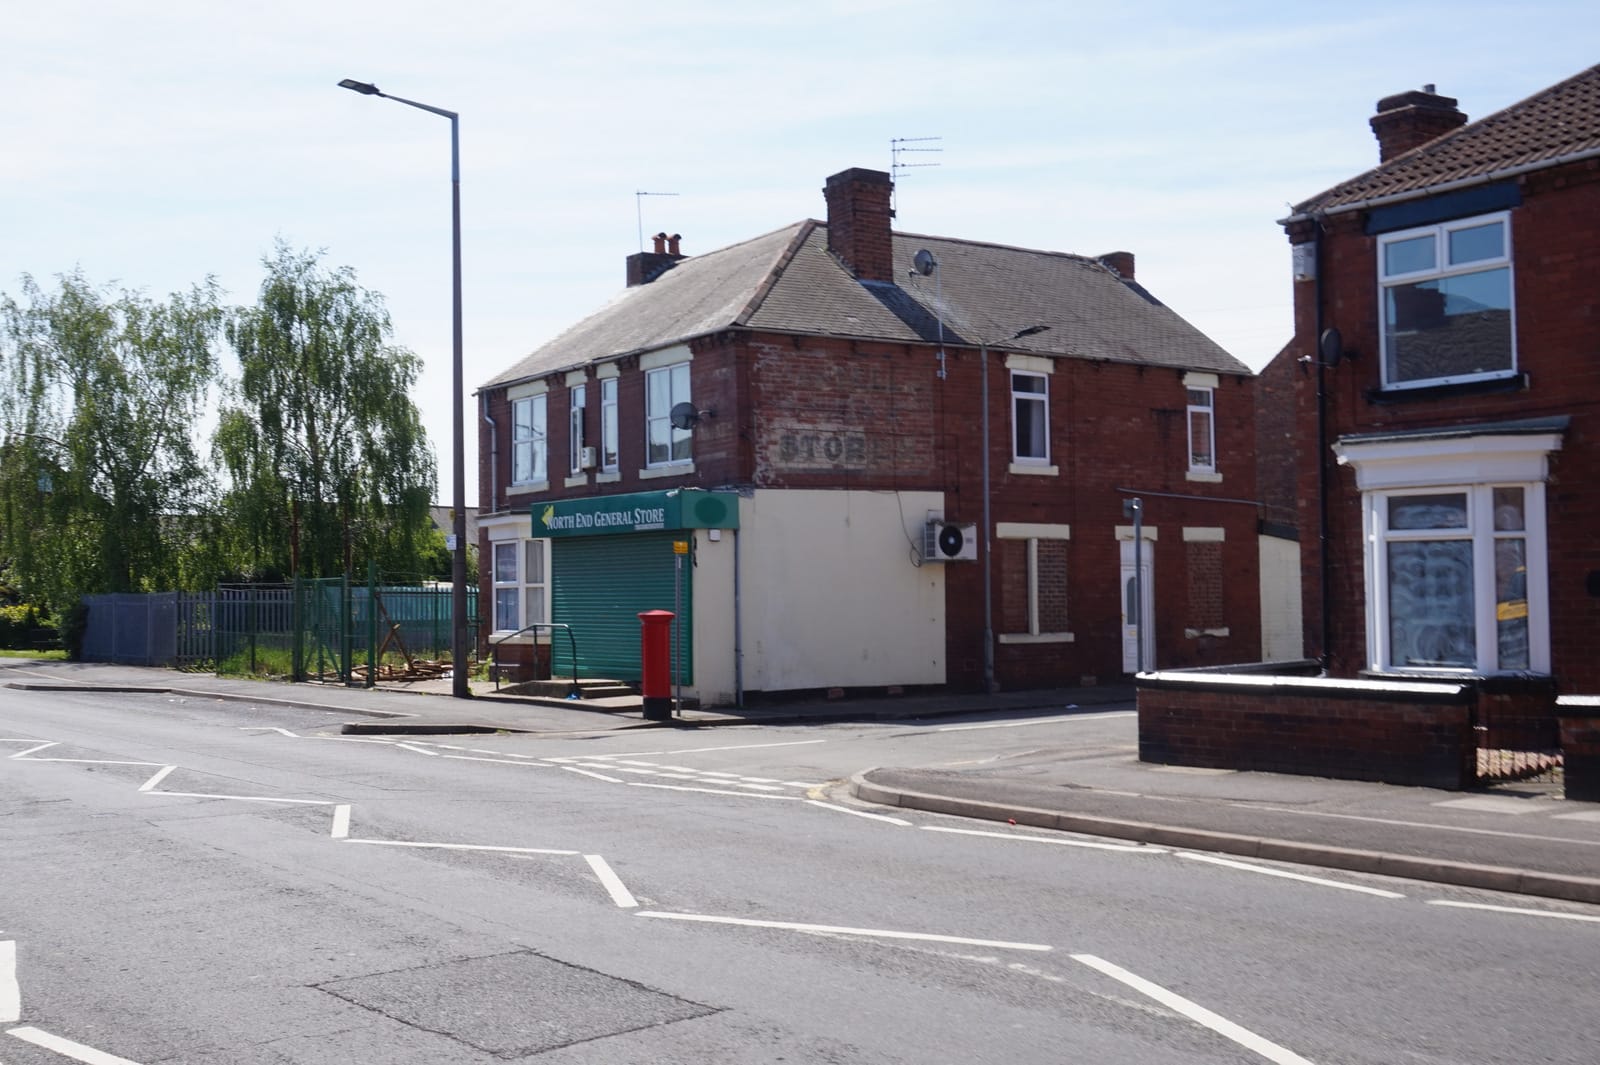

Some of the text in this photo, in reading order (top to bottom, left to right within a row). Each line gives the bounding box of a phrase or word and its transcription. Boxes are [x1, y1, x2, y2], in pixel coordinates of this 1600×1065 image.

[547, 508, 664, 530] NORTH END GENERAL STORE
